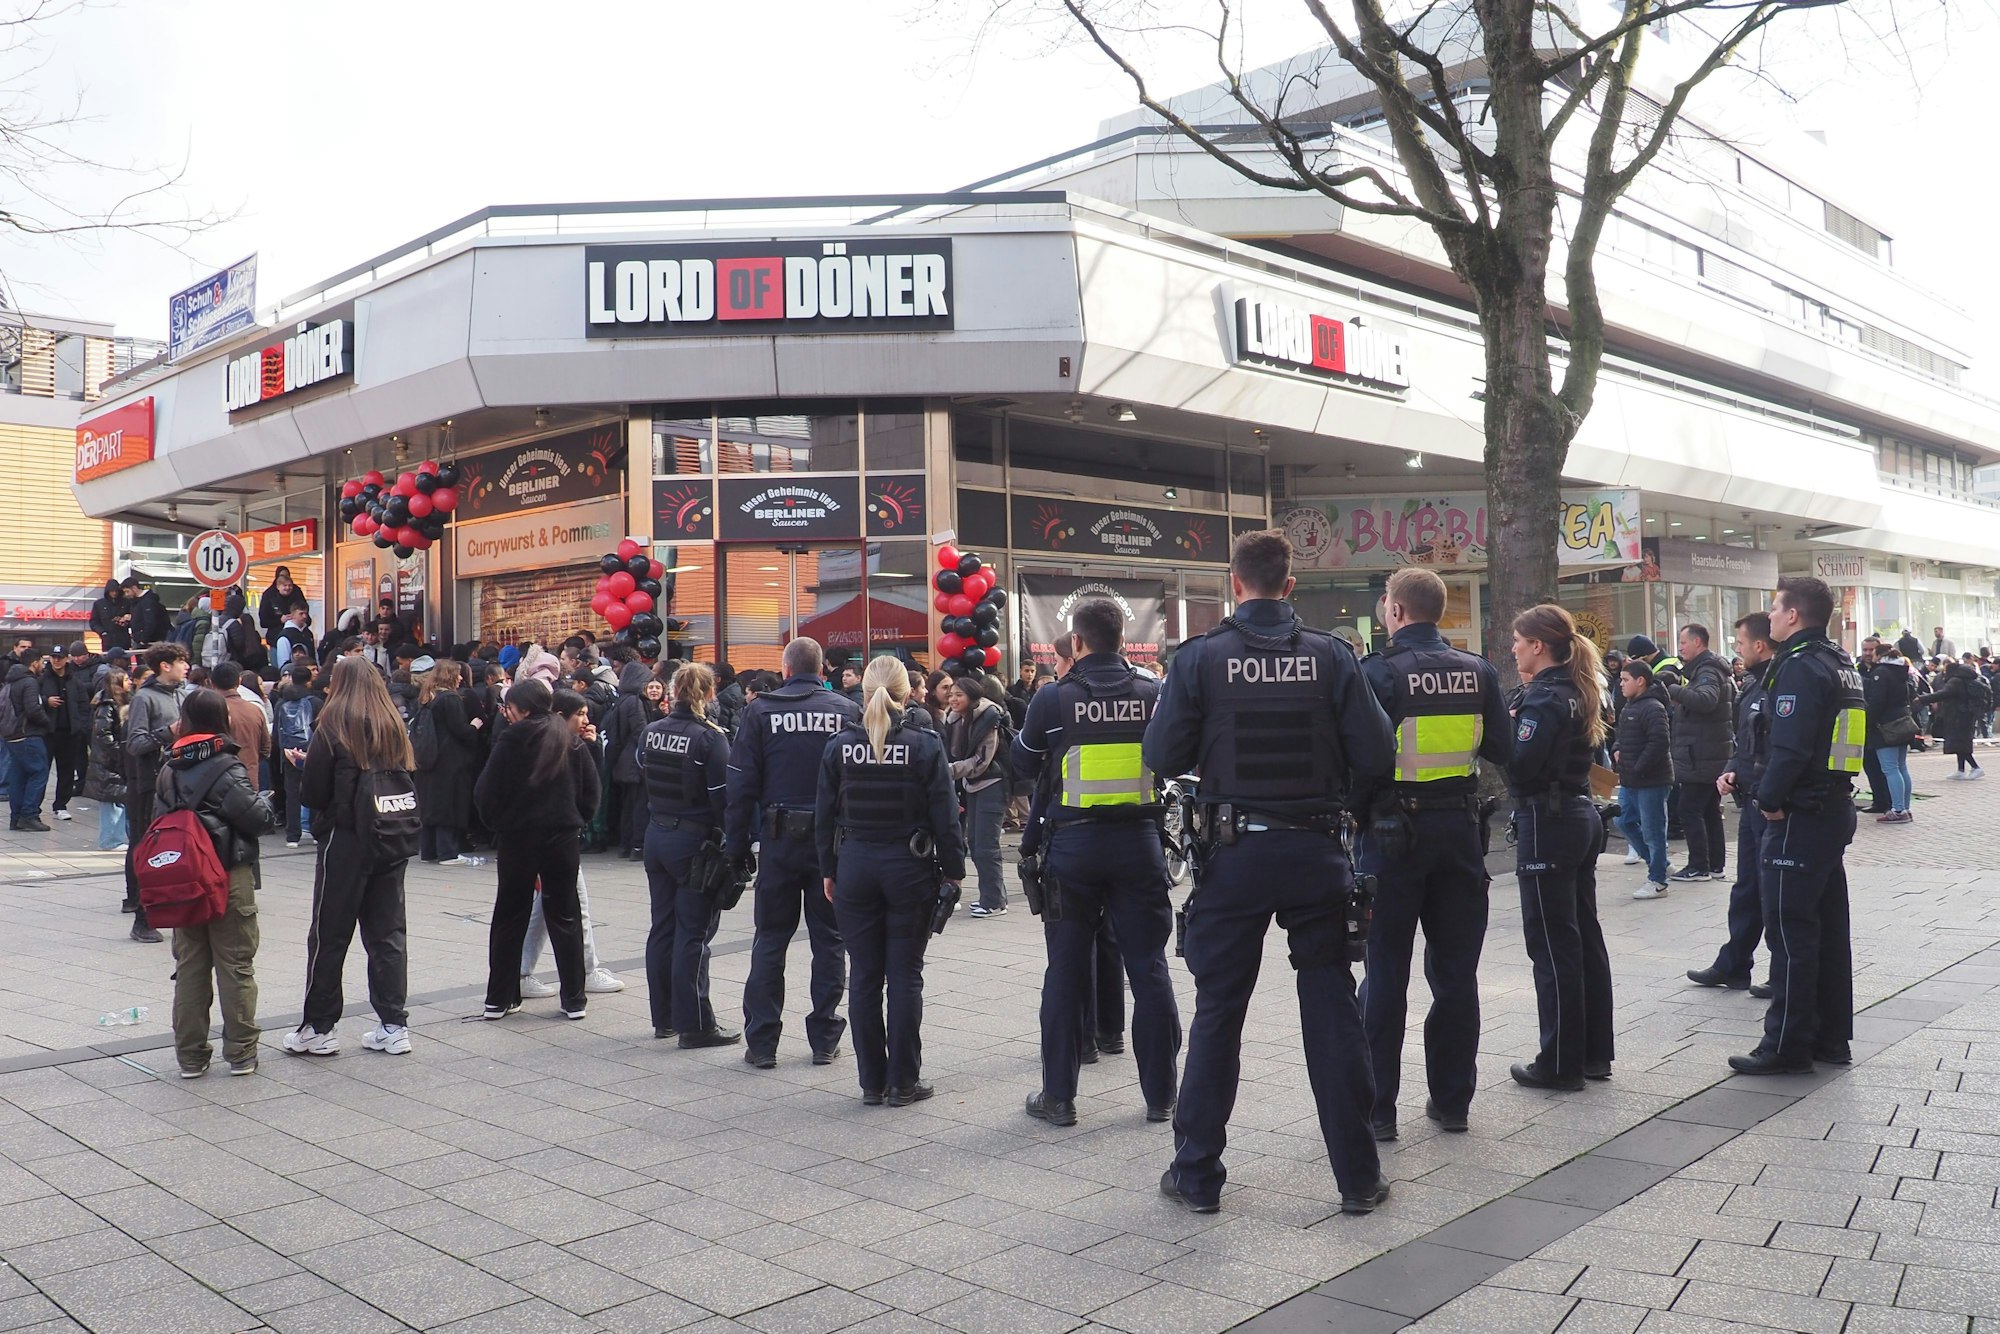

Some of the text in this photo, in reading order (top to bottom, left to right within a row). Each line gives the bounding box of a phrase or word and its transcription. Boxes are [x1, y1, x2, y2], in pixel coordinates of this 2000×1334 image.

[588, 242, 948, 324] LORD OF DÖNER
[187, 287, 213, 313] Schuh
[1246, 297, 1313, 365] LORD
[1317, 324, 1338, 361] OF
[222, 351, 261, 412] LORD
[284, 318, 343, 393] DÖNER
[77, 429, 123, 471] DERPART
[499, 448, 572, 490] Unser Geheimnis liegt
[508, 475, 560, 497] BERLINER
[520, 493, 547, 505] Saucen
[740, 486, 841, 513] Unser Geheimnis liegt
[785, 498, 796, 507] in
[754, 508, 826, 519] BERLINER
[771, 518, 809, 527] Saucen
[1090, 510, 1162, 540] Unser Geheimnis liegt
[1560, 502, 1615, 550] EA
[467, 521, 610, 558] Currywurst & Pommes
[1101, 533, 1153, 547] BERLINER
[1114, 544, 1140, 555] Saucen
[1691, 553, 1725, 569] Haarstudio
[1725, 556, 1752, 574] Freestyle
[1817, 556, 1866, 577] SCHMIDT
[1823, 553, 1858, 563] Brillen
[14, 604, 91, 621] Sparkasse
[1056, 582, 1136, 622] ERÖFFNUNGSANGEBOT
[1227, 656, 1318, 683] POLIZEI
[1407, 671, 1479, 695] POLIZEI
[770, 712, 842, 734] POLIZEI
[1074, 700, 1146, 723] POLIZEI
[645, 731, 691, 754] POLIZEI
[842, 744, 909, 765] POLZEI
[374, 791, 417, 814] VANS
[1772, 859, 1794, 867] POLIZEI
